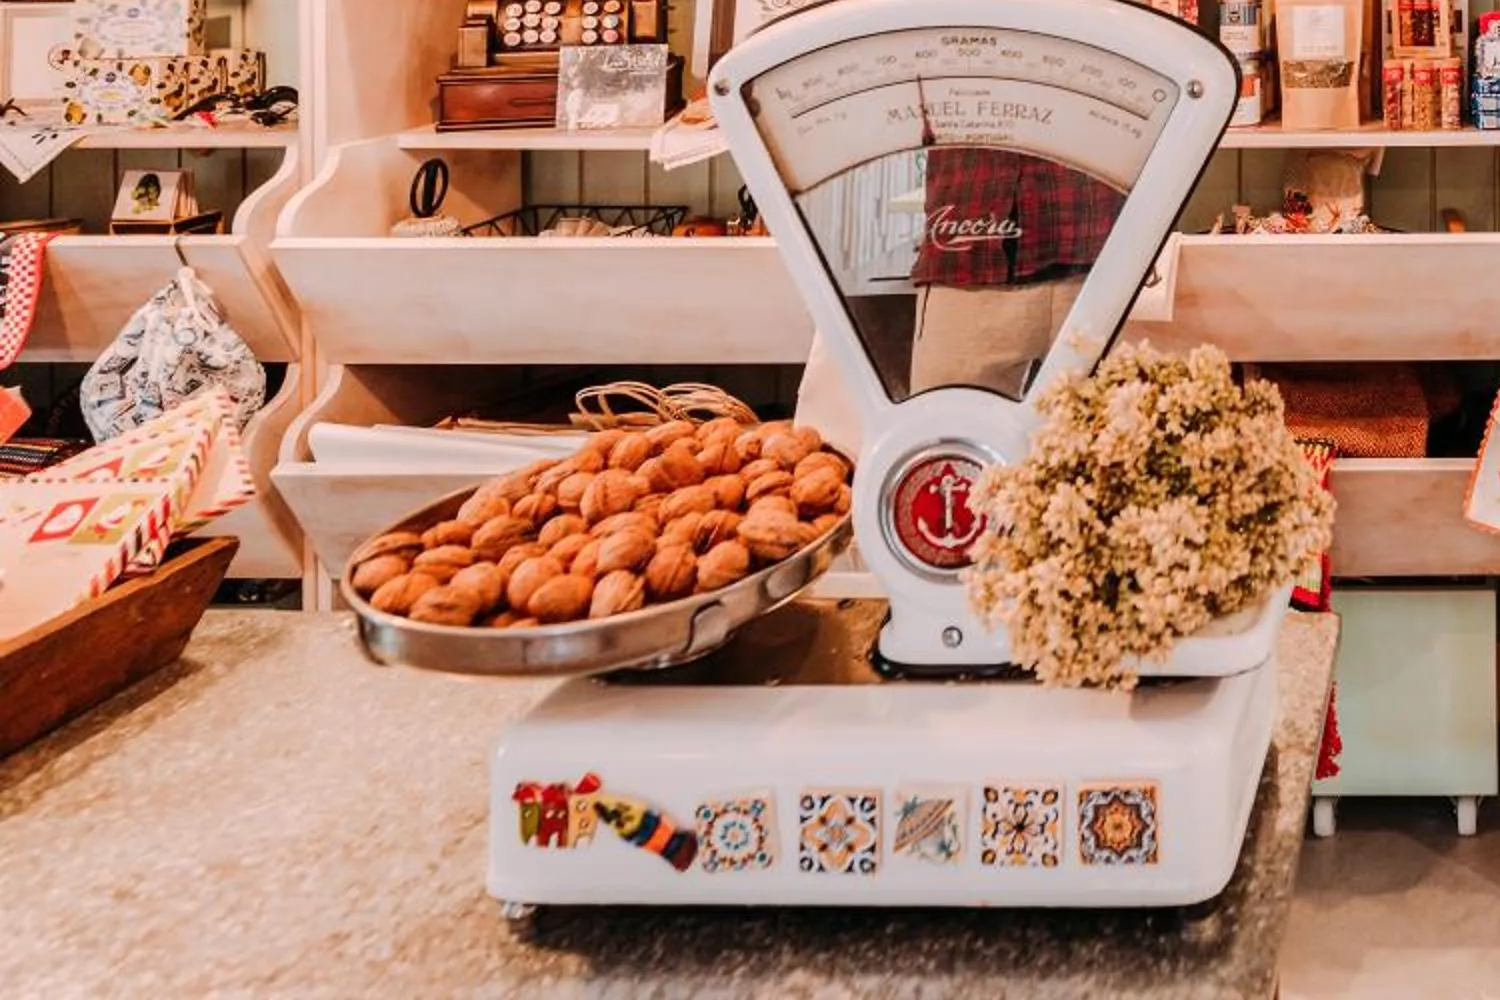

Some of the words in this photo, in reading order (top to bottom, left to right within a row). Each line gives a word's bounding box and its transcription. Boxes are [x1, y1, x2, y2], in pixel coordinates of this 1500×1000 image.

[941, 36, 997, 47] GRAMAS
[957, 48, 981, 58] 500
[977, 101, 1055, 126] FERRAZ
